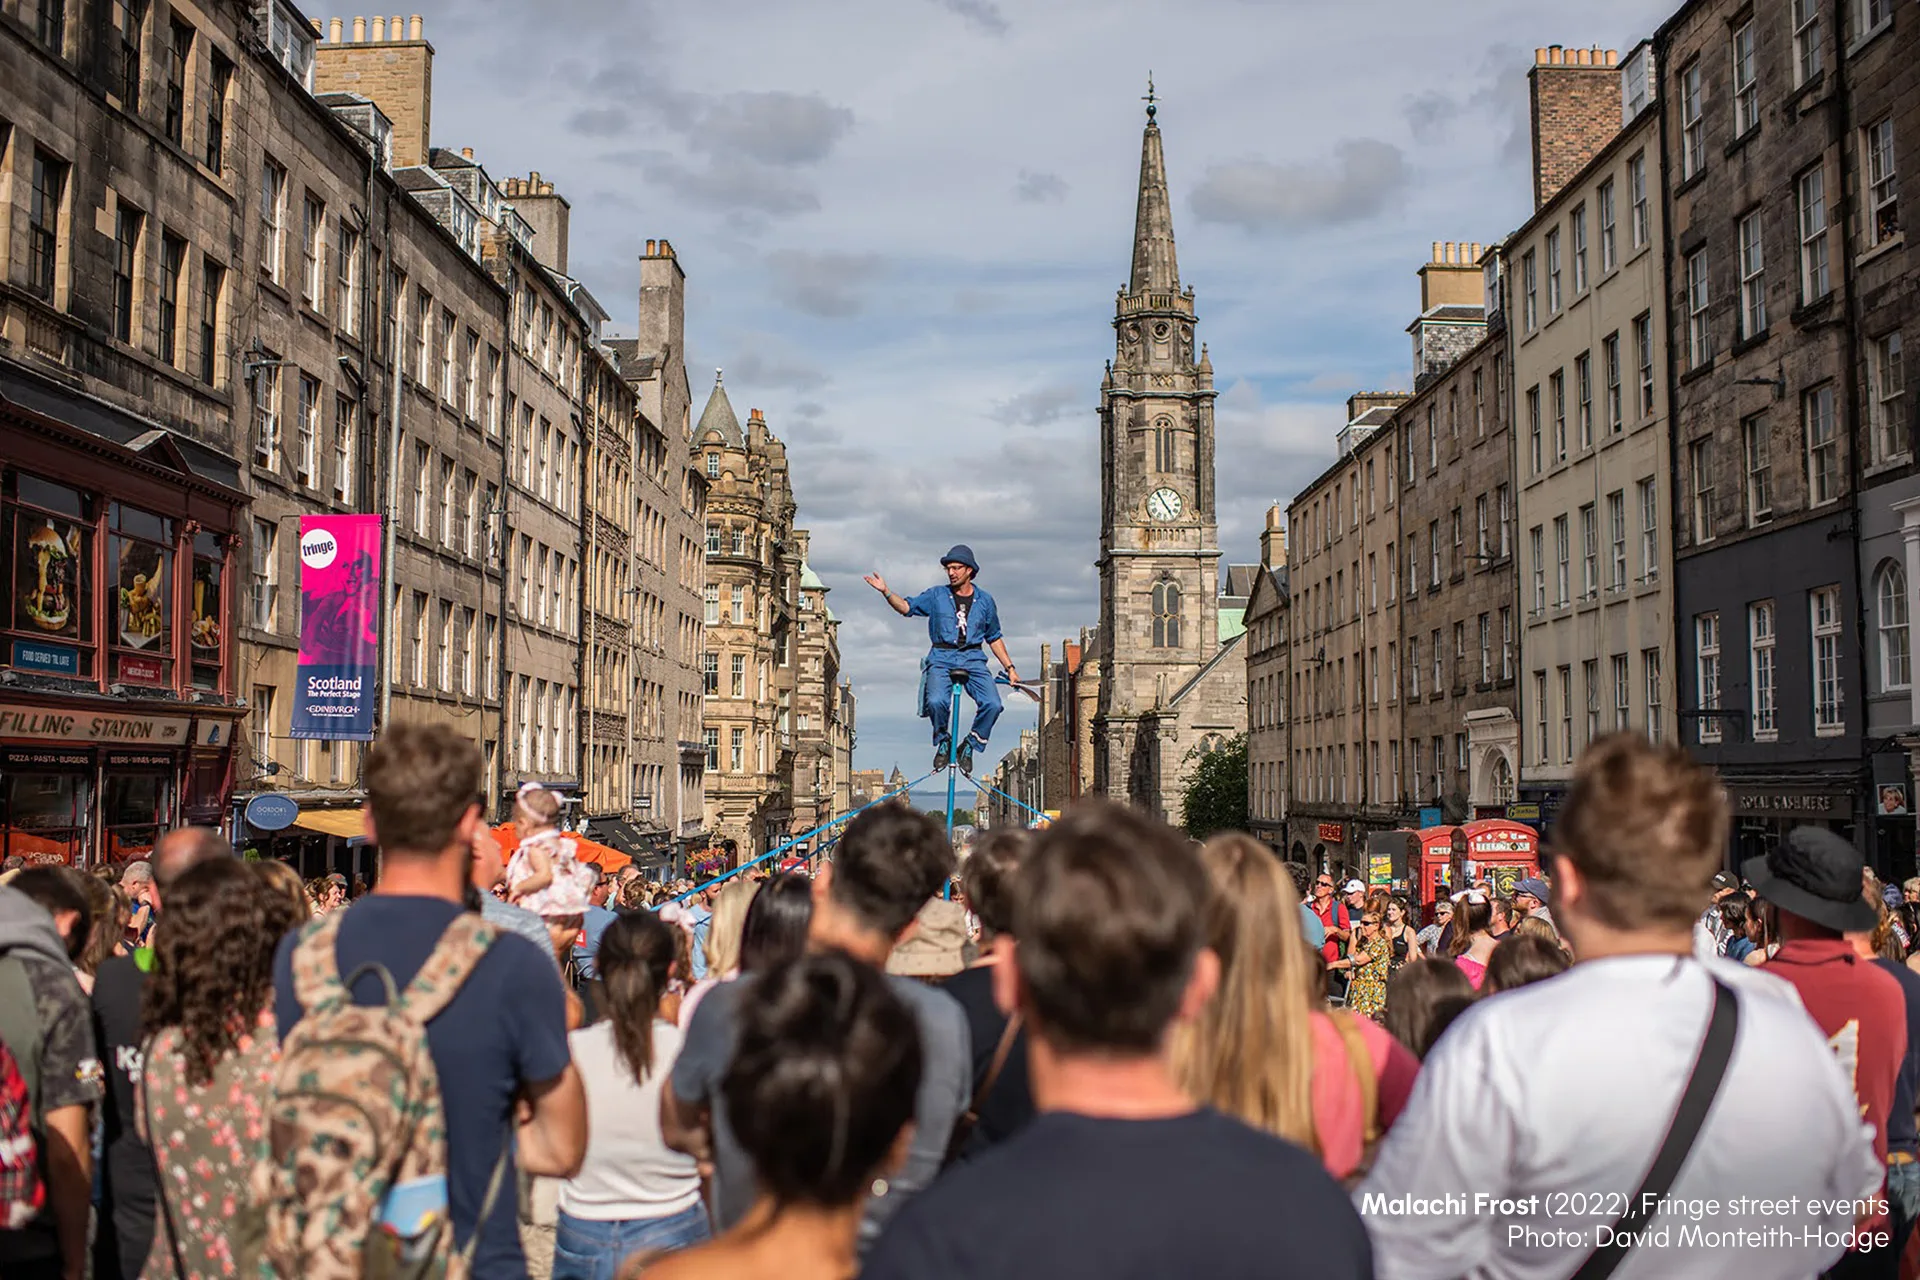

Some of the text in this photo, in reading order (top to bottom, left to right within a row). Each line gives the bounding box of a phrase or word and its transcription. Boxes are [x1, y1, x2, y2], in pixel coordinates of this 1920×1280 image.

[302, 541, 333, 556] fringe
[22, 650, 34, 661] FOOD
[308, 676, 362, 690] Scotland
[343, 691, 361, 699] Stage
[0, 712, 75, 736] FILLING
[89, 717, 153, 738] STATION
[9, 754, 88, 764] PIZZA PASTA BURGERS
[1740, 796, 1831, 811] ROYAL CASHMERE
